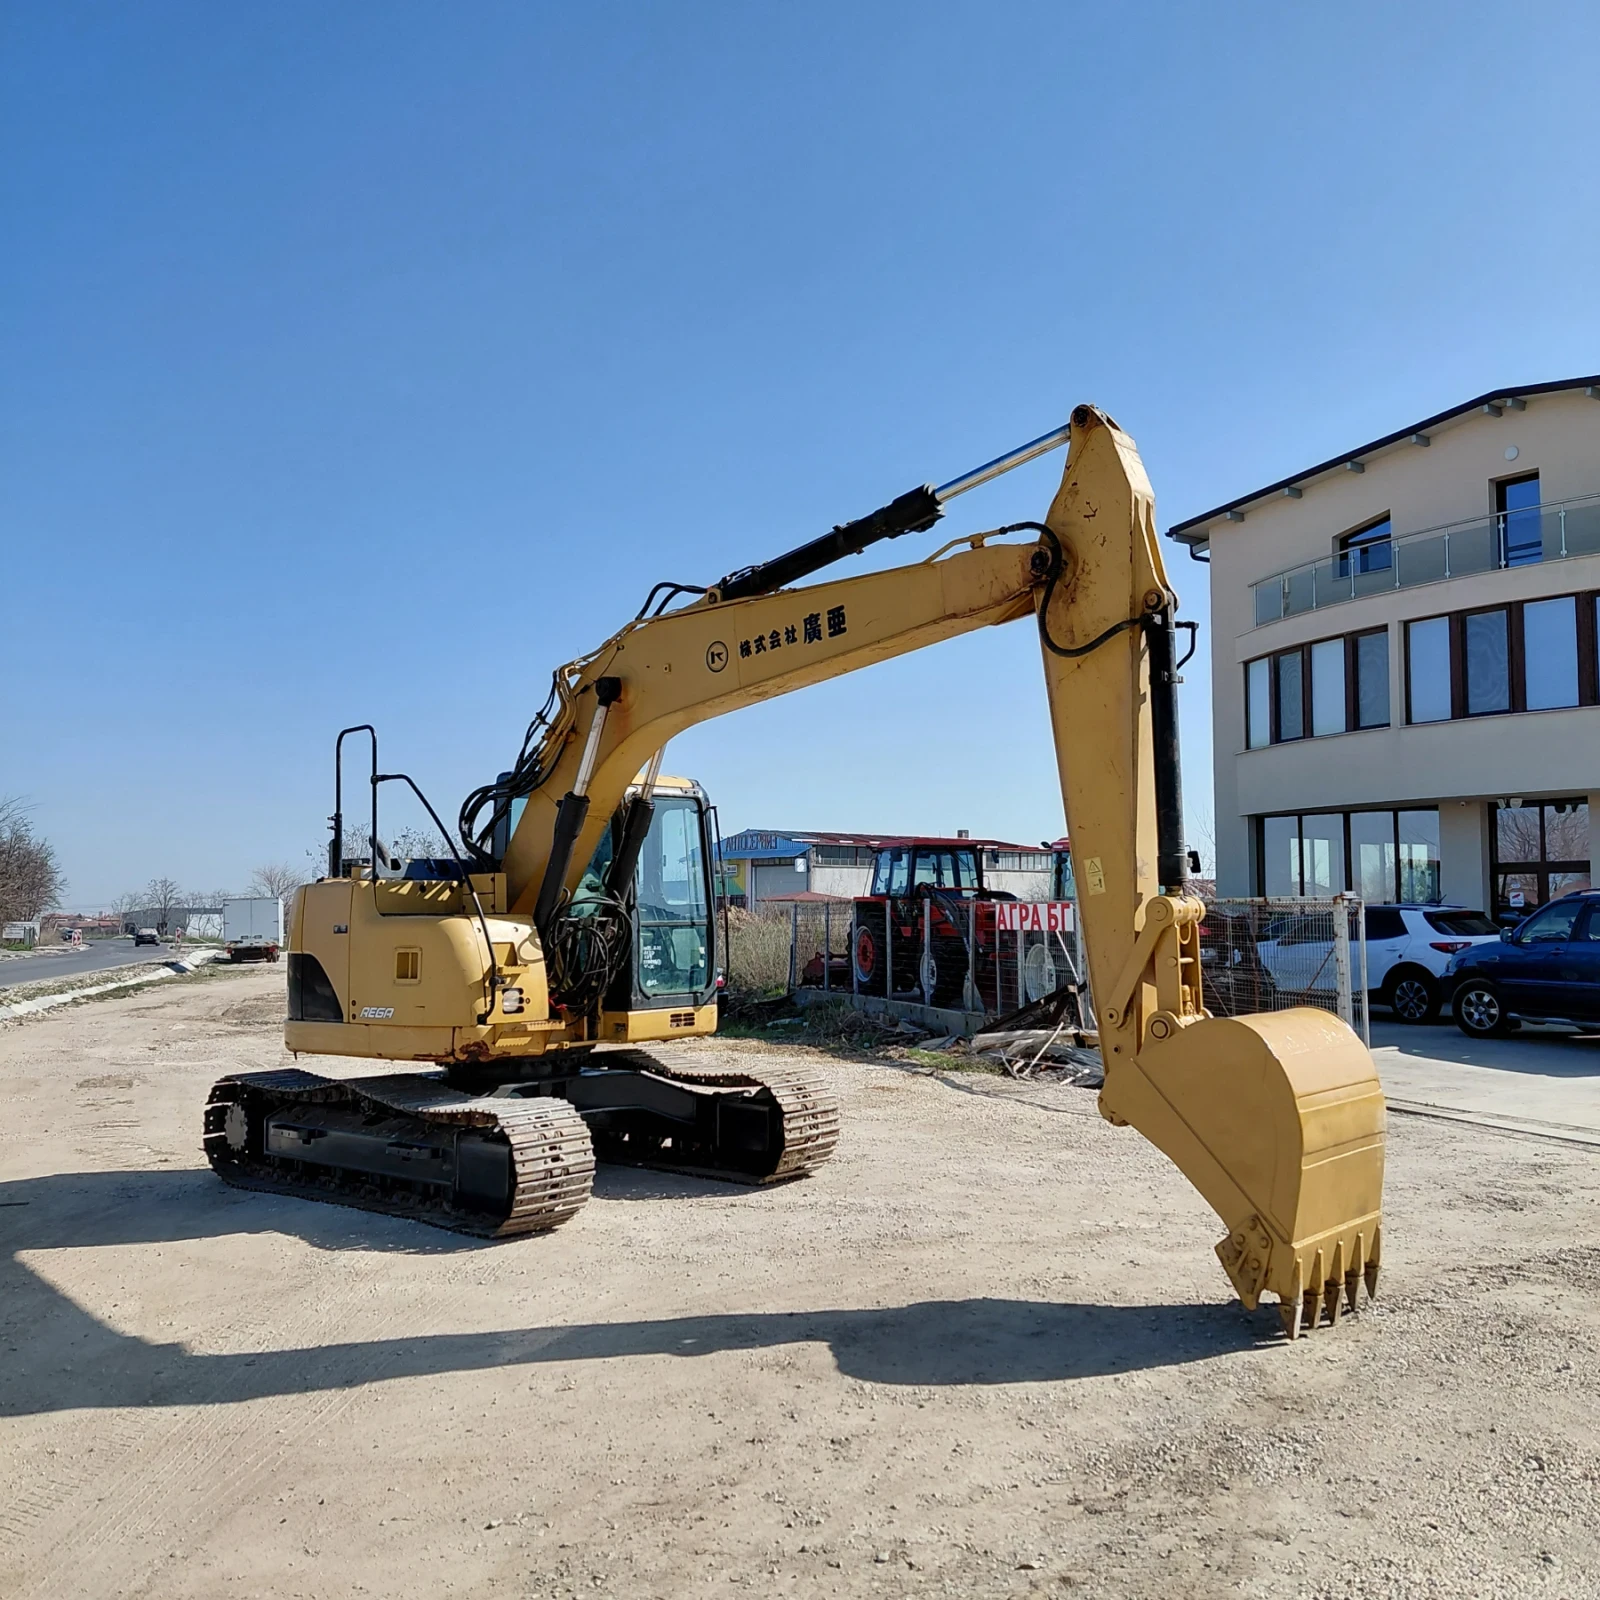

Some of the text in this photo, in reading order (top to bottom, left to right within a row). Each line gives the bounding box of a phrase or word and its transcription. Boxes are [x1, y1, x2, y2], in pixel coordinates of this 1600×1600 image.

[997, 902, 1071, 931] АГРА БГ
[359, 1006, 395, 1019] REGA
